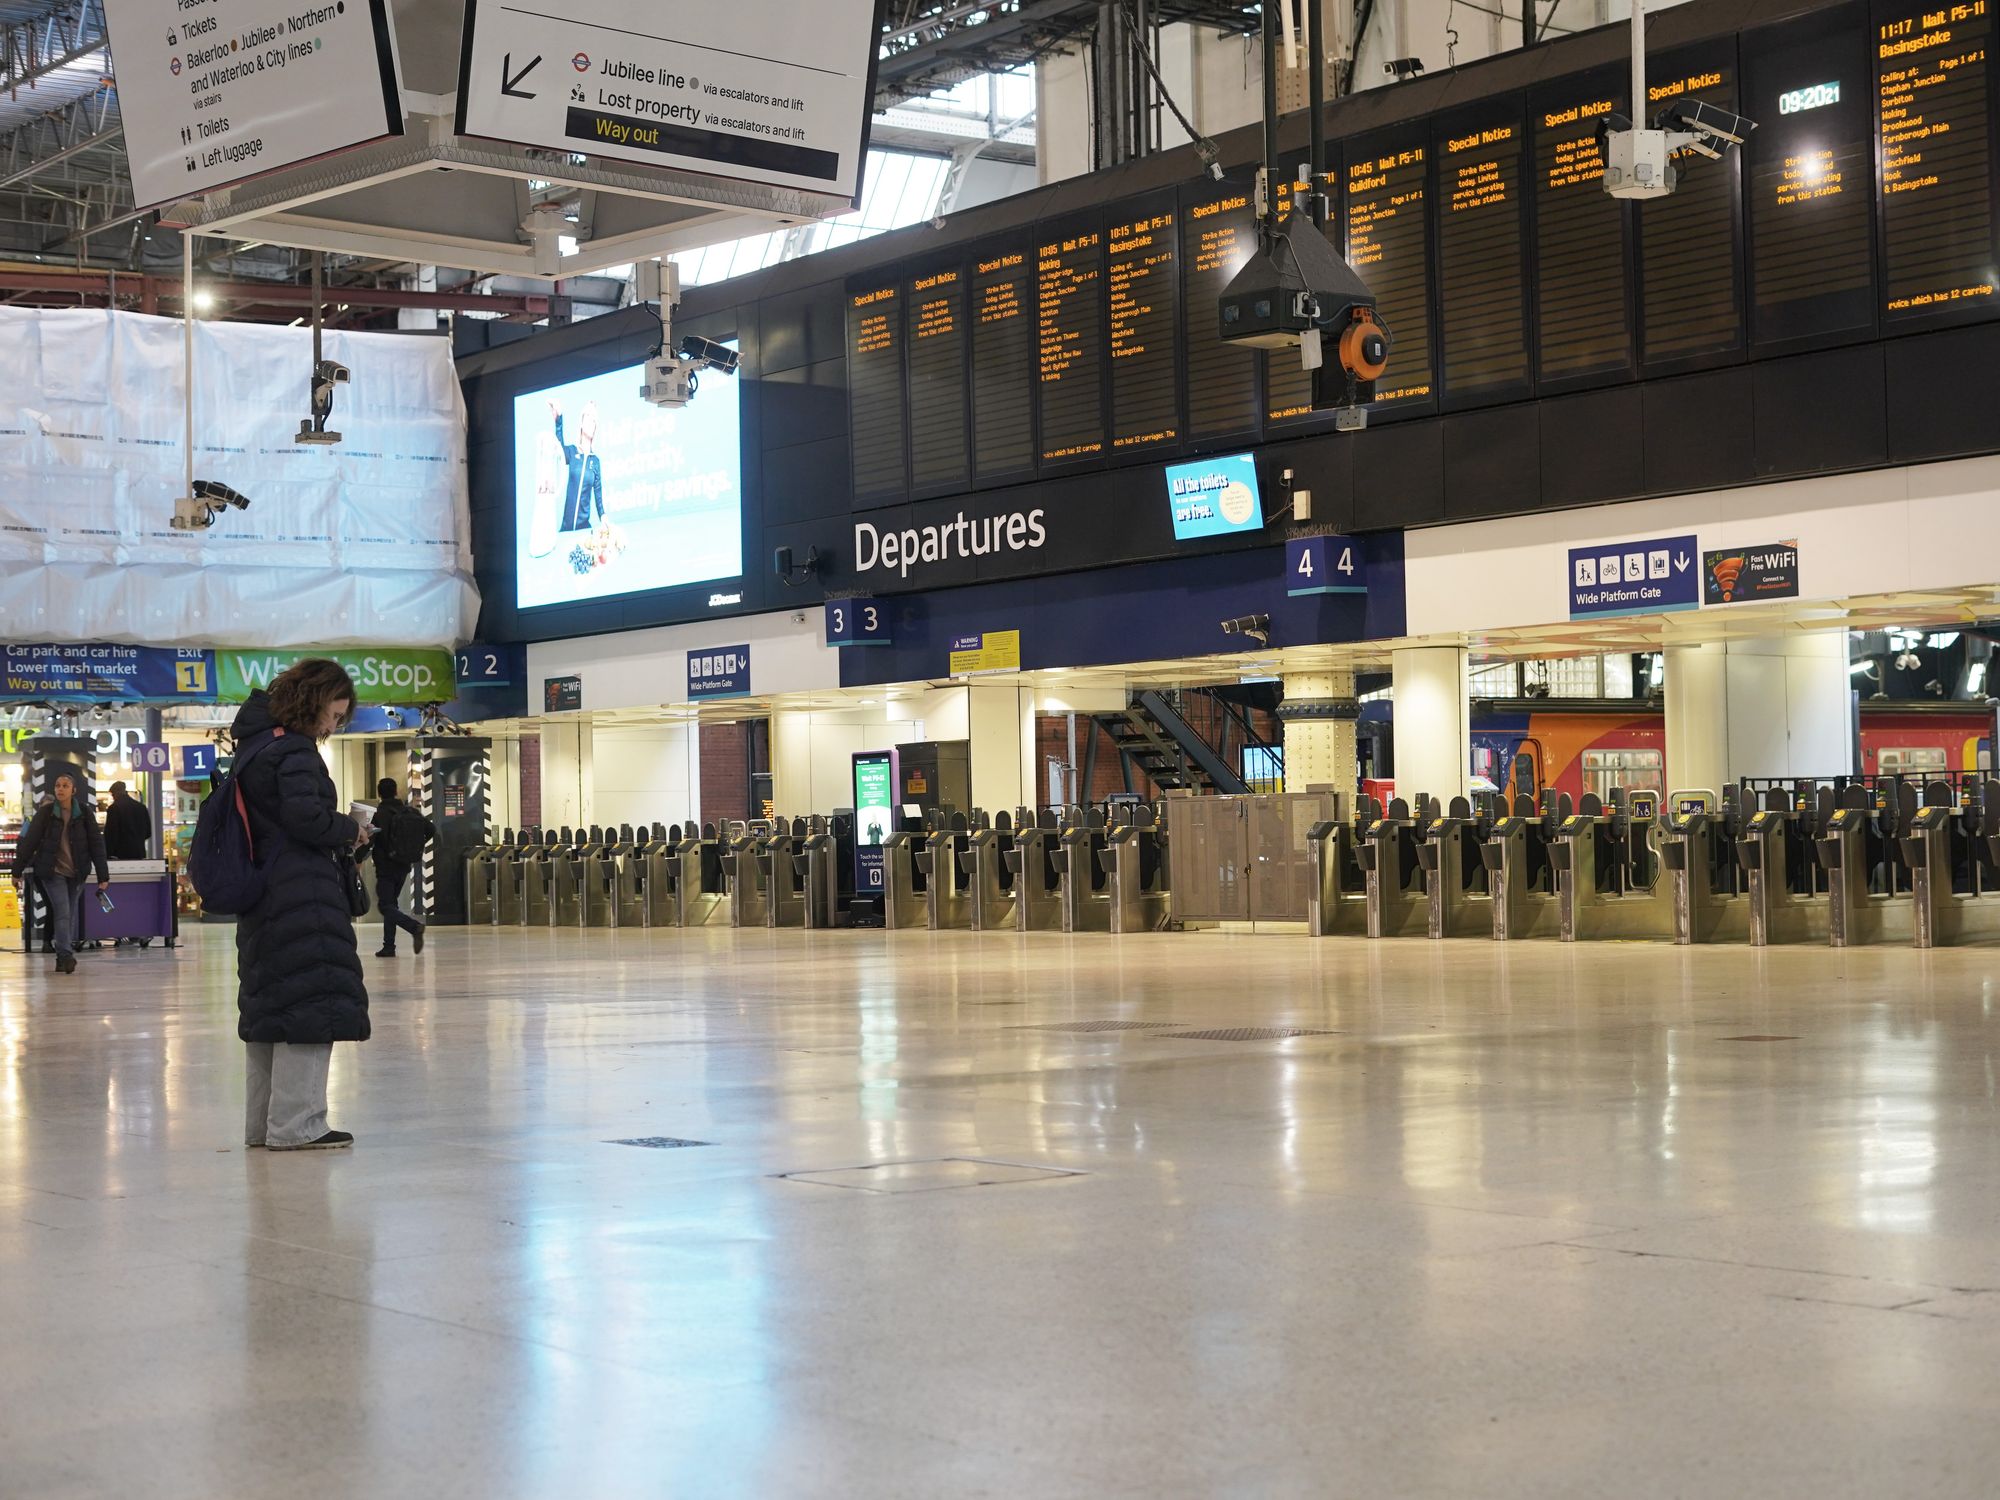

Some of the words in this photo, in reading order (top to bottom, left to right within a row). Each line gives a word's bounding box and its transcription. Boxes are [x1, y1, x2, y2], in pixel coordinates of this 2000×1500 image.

[182, 16, 218, 40] Tickets
[1881, 19, 1912, 39] 11:17
[1922, 10, 1946, 29] Wait
[1951, 1, 1984, 21] P5-11
[186, 41, 229, 70] Bakerloo
[241, 25, 276, 51] Jubilee
[288, 6, 336, 34] Northern
[1880, 31, 1951, 58] Basingstoke
[190, 74, 209, 94] and
[211, 59, 255, 89] Waterloo
[257, 54, 265, 72] &
[266, 48, 286, 72] City
[288, 38, 314, 61] lines
[1940, 59, 1958, 70] Page
[1960, 55, 1966, 64] 1
[1968, 52, 1977, 62] of
[1980, 50, 1984, 59] 1
[1881, 72, 1906, 83] Calling
[1908, 66, 1919, 77] at:
[600, 58, 655, 84] Jubilee
[658, 68, 686, 89] line
[703, 82, 718, 95] via
[720, 86, 769, 106] escalators
[772, 94, 789, 109] and
[791, 98, 804, 112] lift
[1650, 80, 1684, 101] Special
[1688, 72, 1721, 92] Notice
[1881, 83, 1910, 96] Clapham
[1914, 74, 1946, 88] Junction
[193, 98, 203, 110] via
[204, 92, 222, 108] stairs
[1882, 94, 1914, 108] Surbiton
[598, 88, 631, 110] Lost
[635, 96, 700, 125] property
[704, 112, 719, 125] via
[720, 117, 770, 136] escalators
[772, 124, 790, 138] and
[792, 127, 805, 141] lift
[1546, 107, 1578, 128] Special
[1582, 100, 1612, 118] Notice
[1882, 108, 1907, 120] Woking
[1882, 116, 1923, 132] Brookwood
[198, 116, 230, 141] Toilets
[596, 118, 630, 143] Way
[633, 126, 659, 145] out
[1883, 127, 1930, 144] Farnborough
[1932, 122, 1950, 134] Main
[1449, 134, 1479, 152] Special
[1482, 128, 1511, 143] Notice
[202, 150, 222, 169] Left
[224, 137, 263, 166] luggage
[1883, 145, 1903, 157] Fleet
[1350, 162, 1372, 178] 10:45
[1379, 156, 1396, 170] Wait
[1400, 149, 1422, 165] P5-11
[1459, 168, 1478, 178] Strike
[1350, 174, 1386, 193] Guildford
[1892, 176, 1938, 192] Basingstoke
[1798, 190, 1812, 201] this
[1194, 202, 1218, 218] Special
[1222, 196, 1246, 212] Notice
[1110, 225, 1130, 239] 10:15
[1135, 221, 1150, 234] Wait
[1152, 214, 1172, 230] P5-11
[1079, 234, 1098, 248] P5-11
[1110, 236, 1152, 254] Basingstoke
[978, 259, 1000, 273] Special
[1002, 254, 1022, 267] Notice
[916, 276, 936, 290] Special
[938, 272, 956, 285] Notice
[855, 294, 874, 307] Special
[876, 288, 894, 302] Notice
[1934, 292, 1948, 302] has
[1951, 289, 1960, 298] 12
[1173, 478, 1185, 495] All
[1186, 476, 1200, 492] the
[1200, 473, 1228, 490] toilets
[855, 508, 1046, 578] Departures
[1298, 549, 1313, 578] 4
[1338, 548, 1354, 576] 4
[1764, 552, 1796, 569] WiFi
[1576, 592, 1598, 605] Wide
[1600, 588, 1638, 602] Platform
[1640, 587, 1662, 598] Gate
[834, 608, 844, 633] 3
[864, 606, 878, 631] 3
[6, 644, 28, 657] Car
[32, 645, 60, 659] park
[64, 646, 87, 658] and
[90, 648, 109, 658] car
[113, 646, 137, 658] hire
[178, 648, 203, 658] Exit
[8, 661, 48, 673] Lower
[52, 662, 90, 674] marsh
[94, 662, 137, 674] market
[461, 656, 469, 676] 2
[484, 654, 498, 675] 2
[8, 678, 36, 692] Way
[40, 679, 62, 690] out
[184, 666, 200, 688] 1
[568, 682, 580, 692] WiFi
[691, 682, 702, 690] Wide
[702, 680, 721, 689] Platform
[722, 678, 732, 688] Gate
[194, 751, 206, 769] 1
